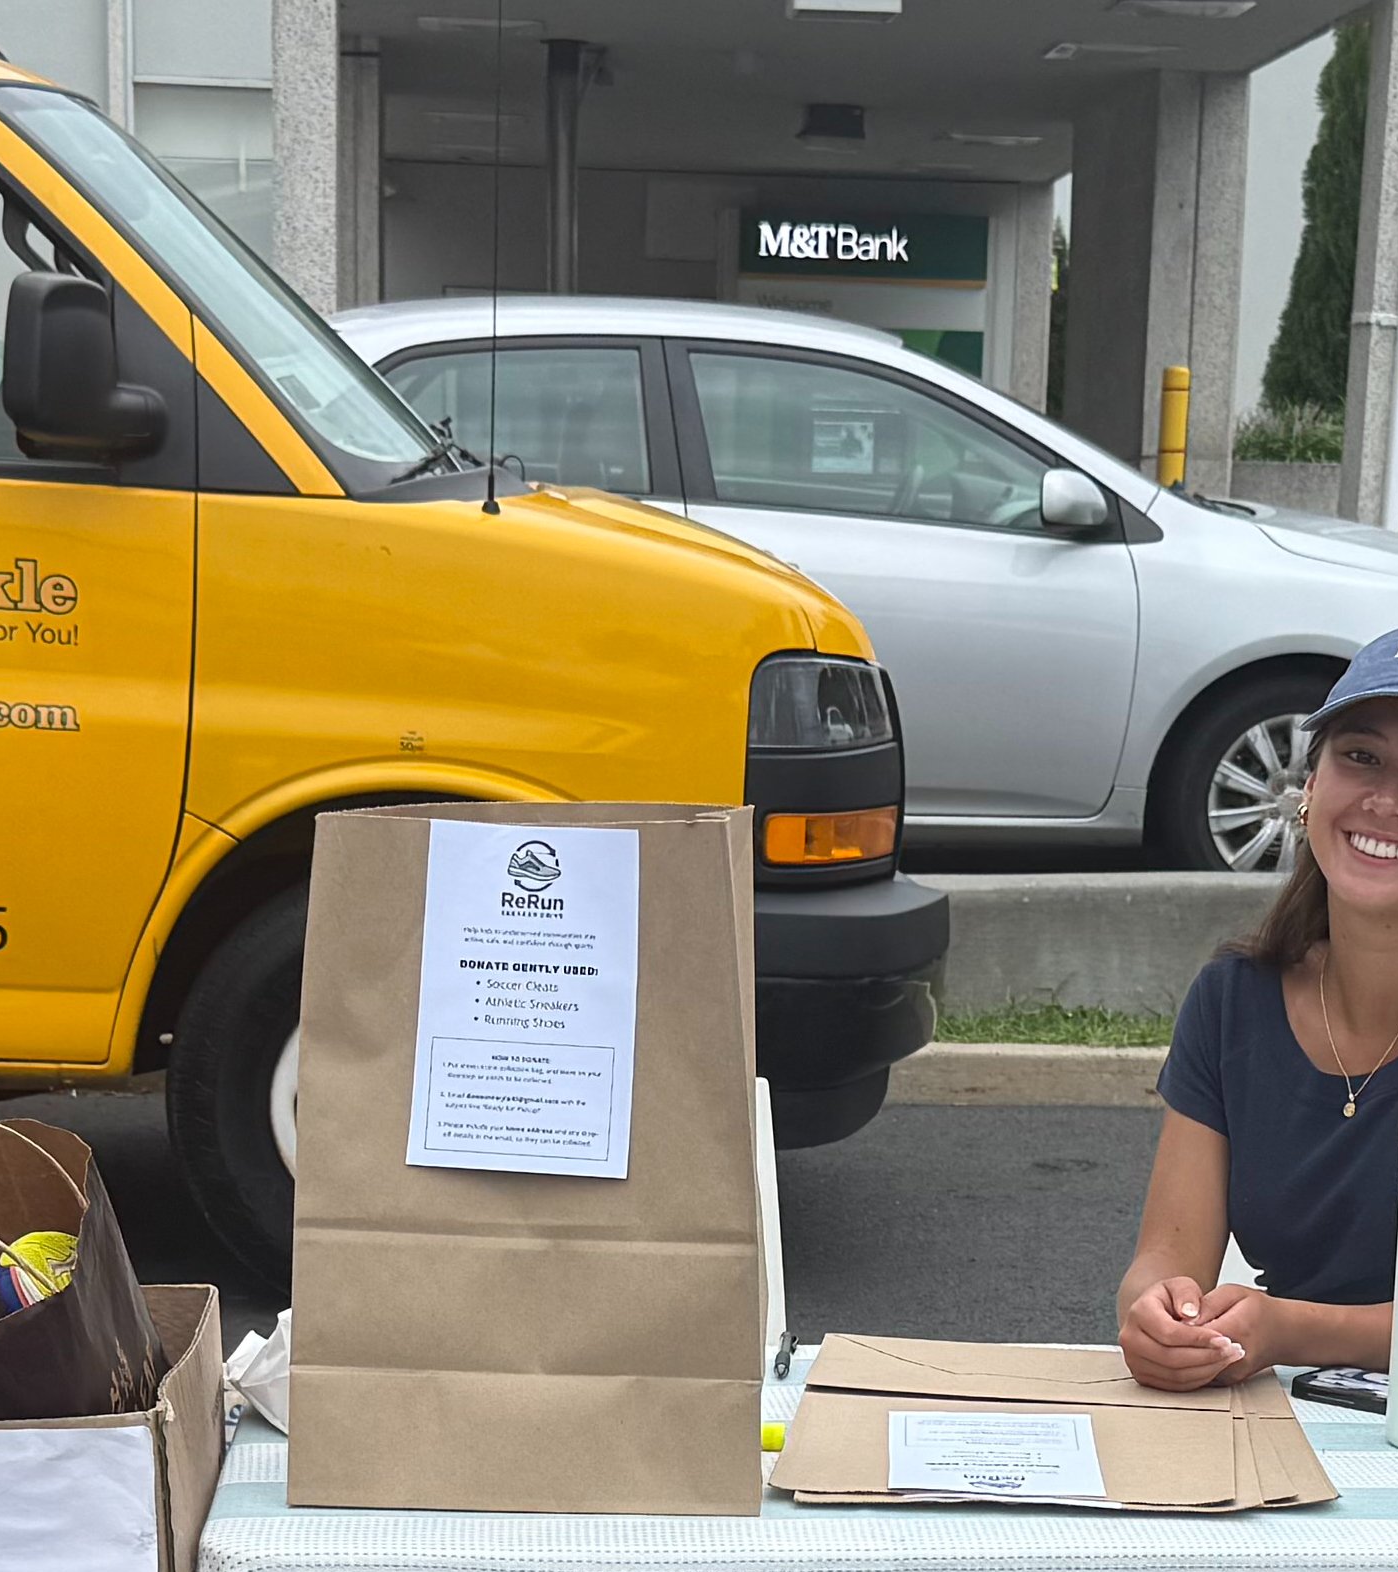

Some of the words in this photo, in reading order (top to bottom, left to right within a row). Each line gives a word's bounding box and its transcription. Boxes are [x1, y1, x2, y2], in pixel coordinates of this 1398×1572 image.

[27, 621, 80, 648] You!
[501, 891, 565, 911] ReRun
[459, 959, 509, 972] DONATE
[512, 962, 560, 974] GENTLY
[486, 978, 521, 991] Soccer
[525, 980, 559, 993] Cleats
[485, 996, 526, 1009] Athletic
[529, 998, 579, 1012] Sneakers
[484, 1014, 530, 1029] Running
[532, 1018, 566, 1030] Shoes
